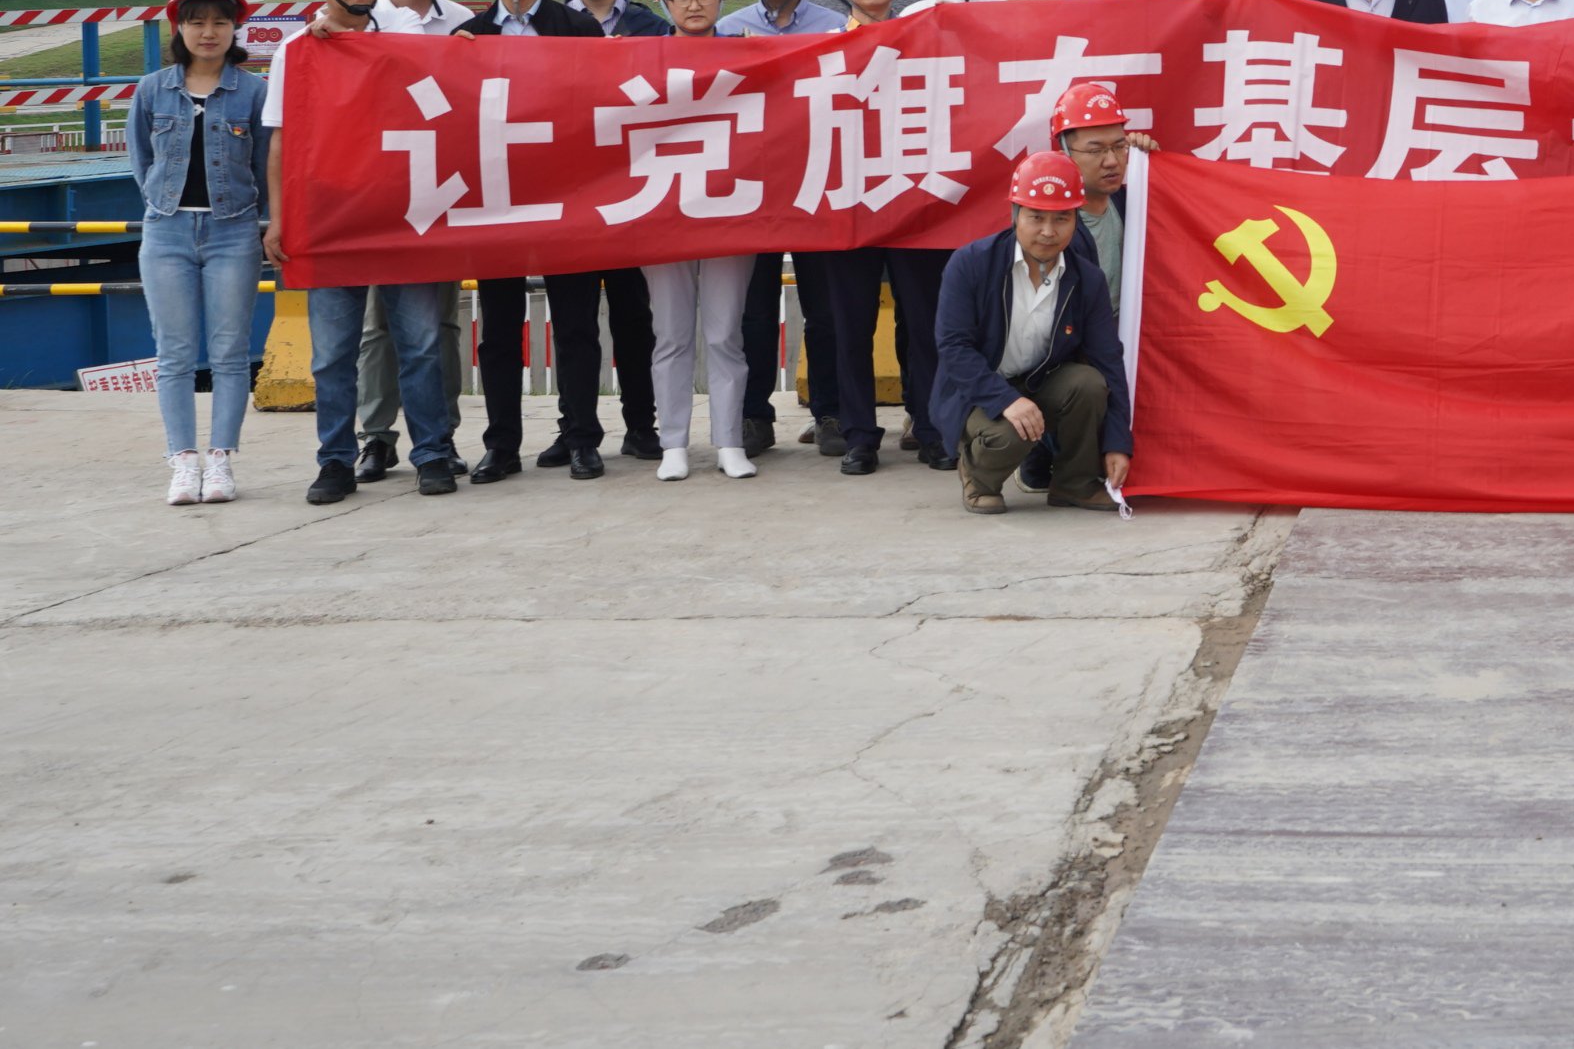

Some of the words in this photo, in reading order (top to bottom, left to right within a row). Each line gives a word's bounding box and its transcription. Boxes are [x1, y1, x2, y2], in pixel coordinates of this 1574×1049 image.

[88, 369, 158, 393] 起重吊装危险
